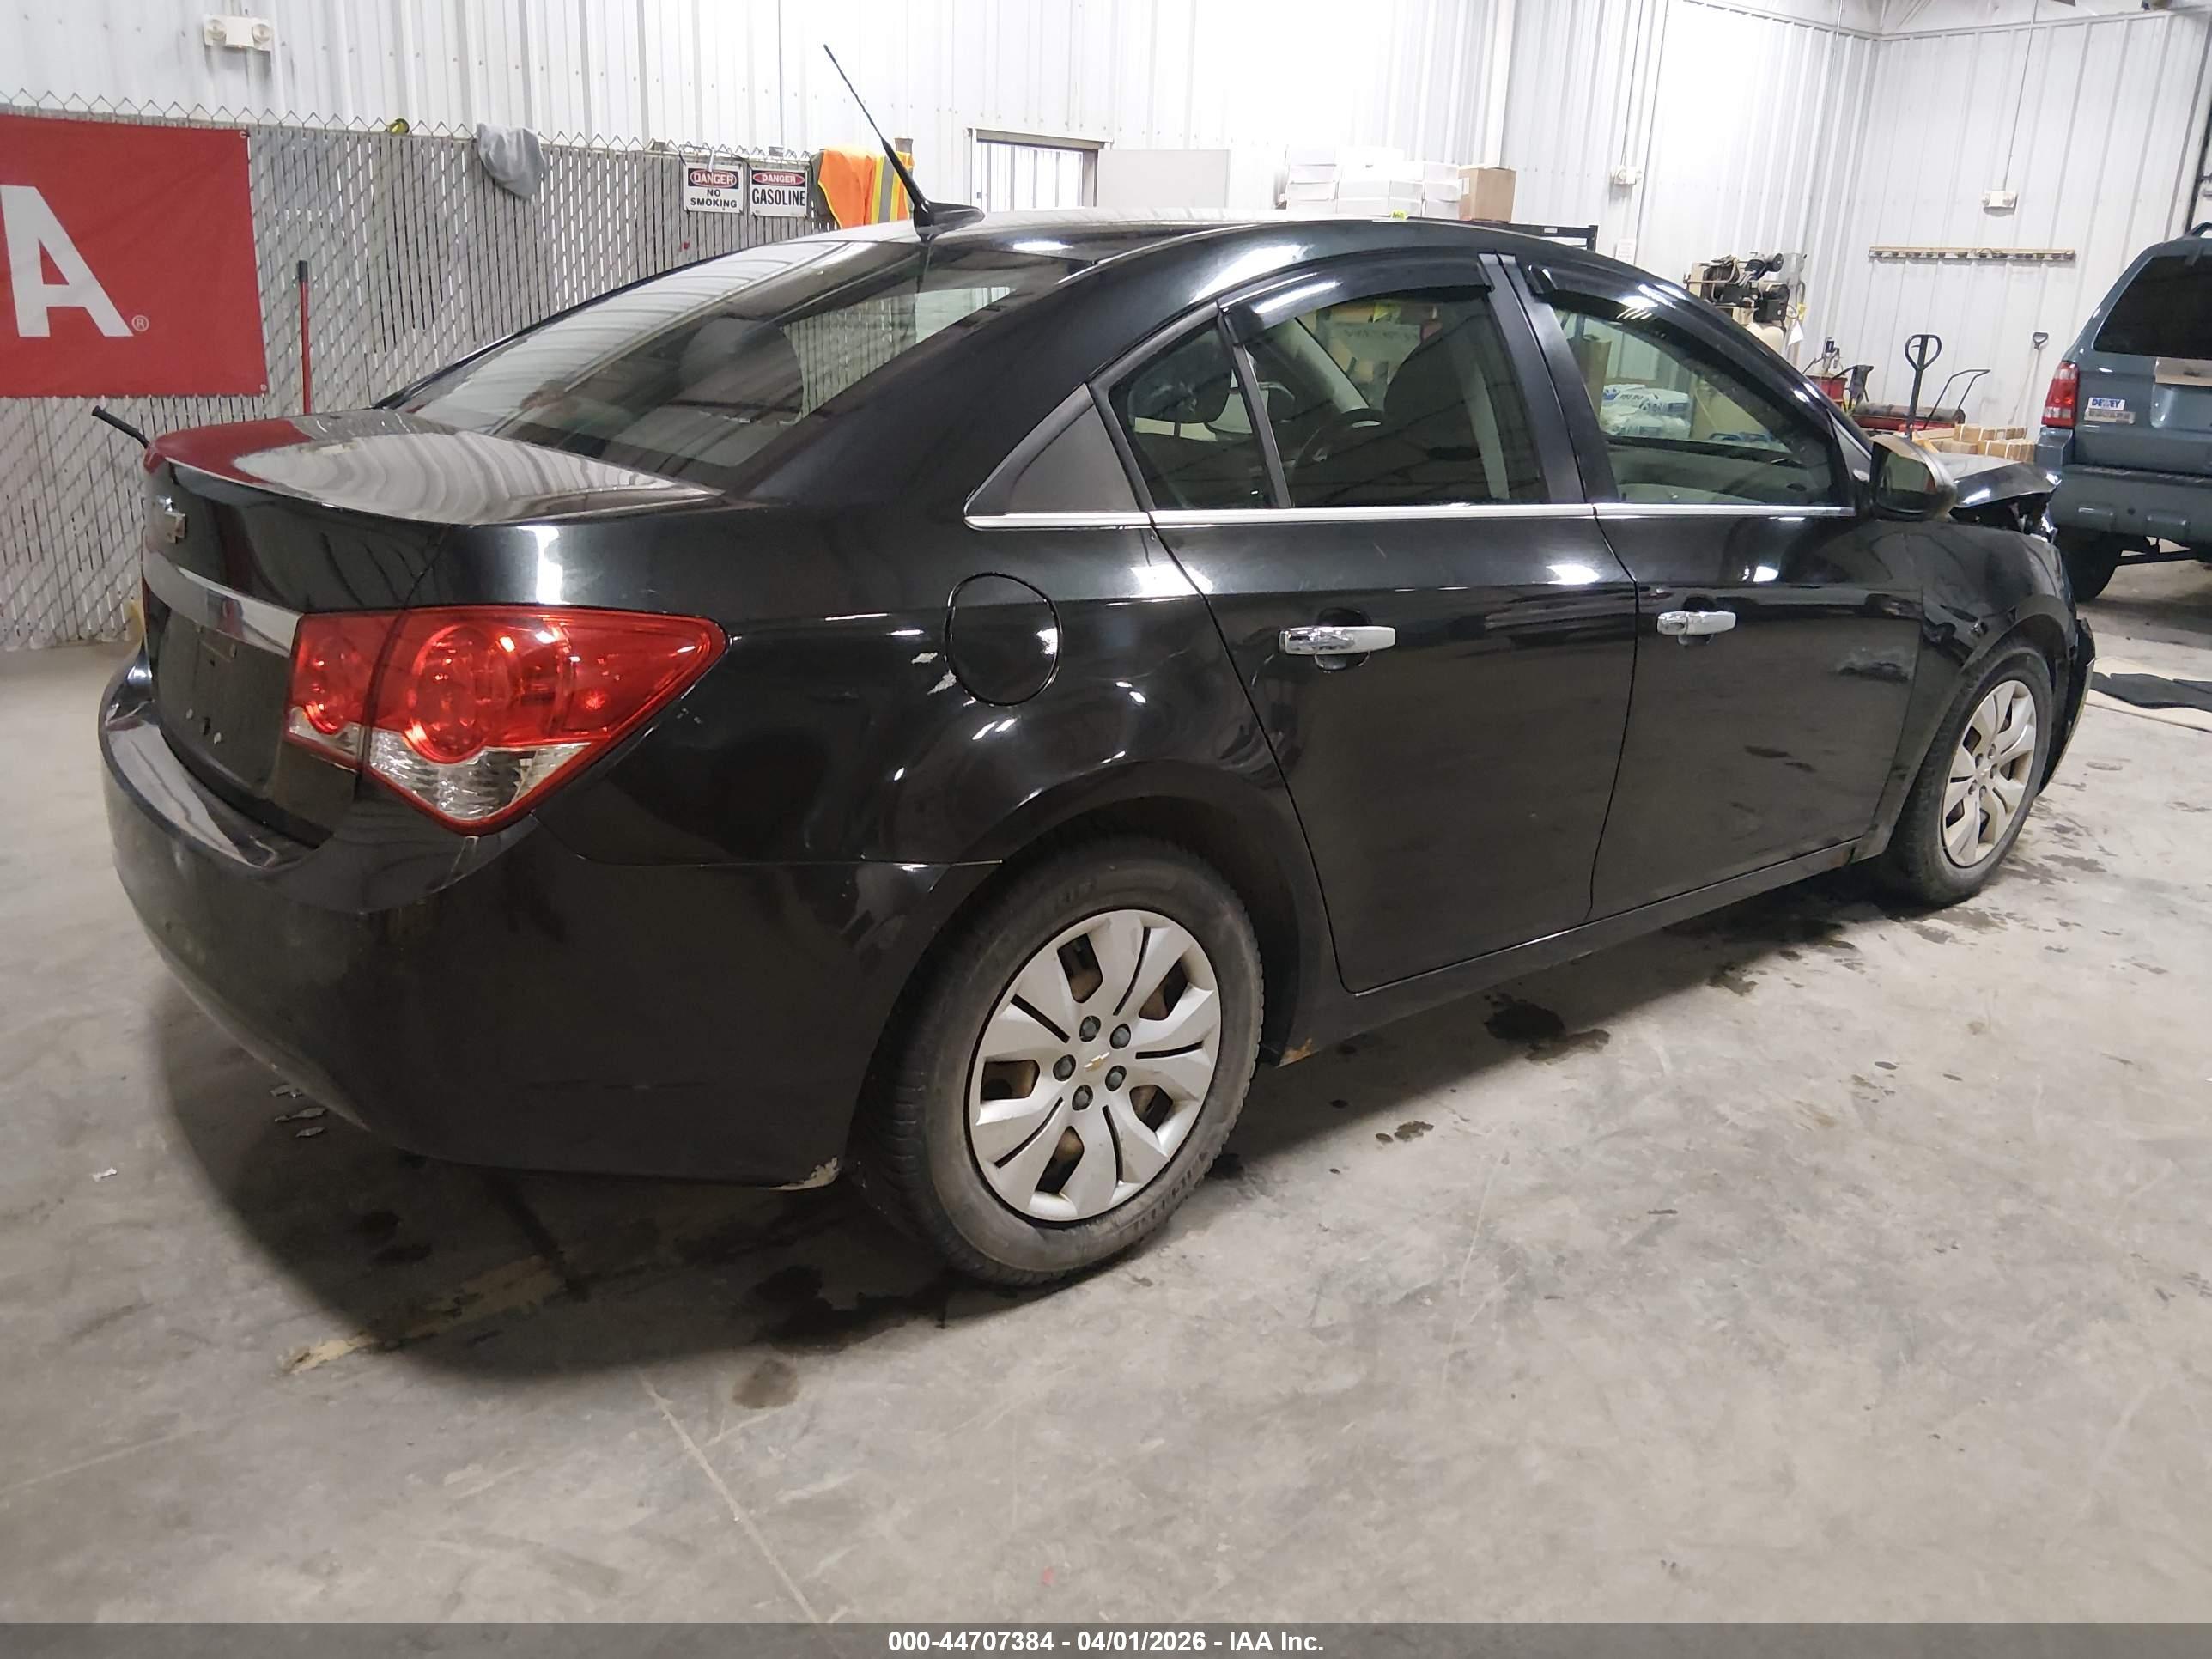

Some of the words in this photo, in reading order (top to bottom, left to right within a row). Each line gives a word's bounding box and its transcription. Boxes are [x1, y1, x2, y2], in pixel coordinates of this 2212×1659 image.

[693, 173, 734, 185] DANGER
[762, 174, 796, 185] DANGER
[690, 198, 737, 208] SMOKING
[751, 188, 805, 206] GASOLINE
[0, 185, 134, 337] A
